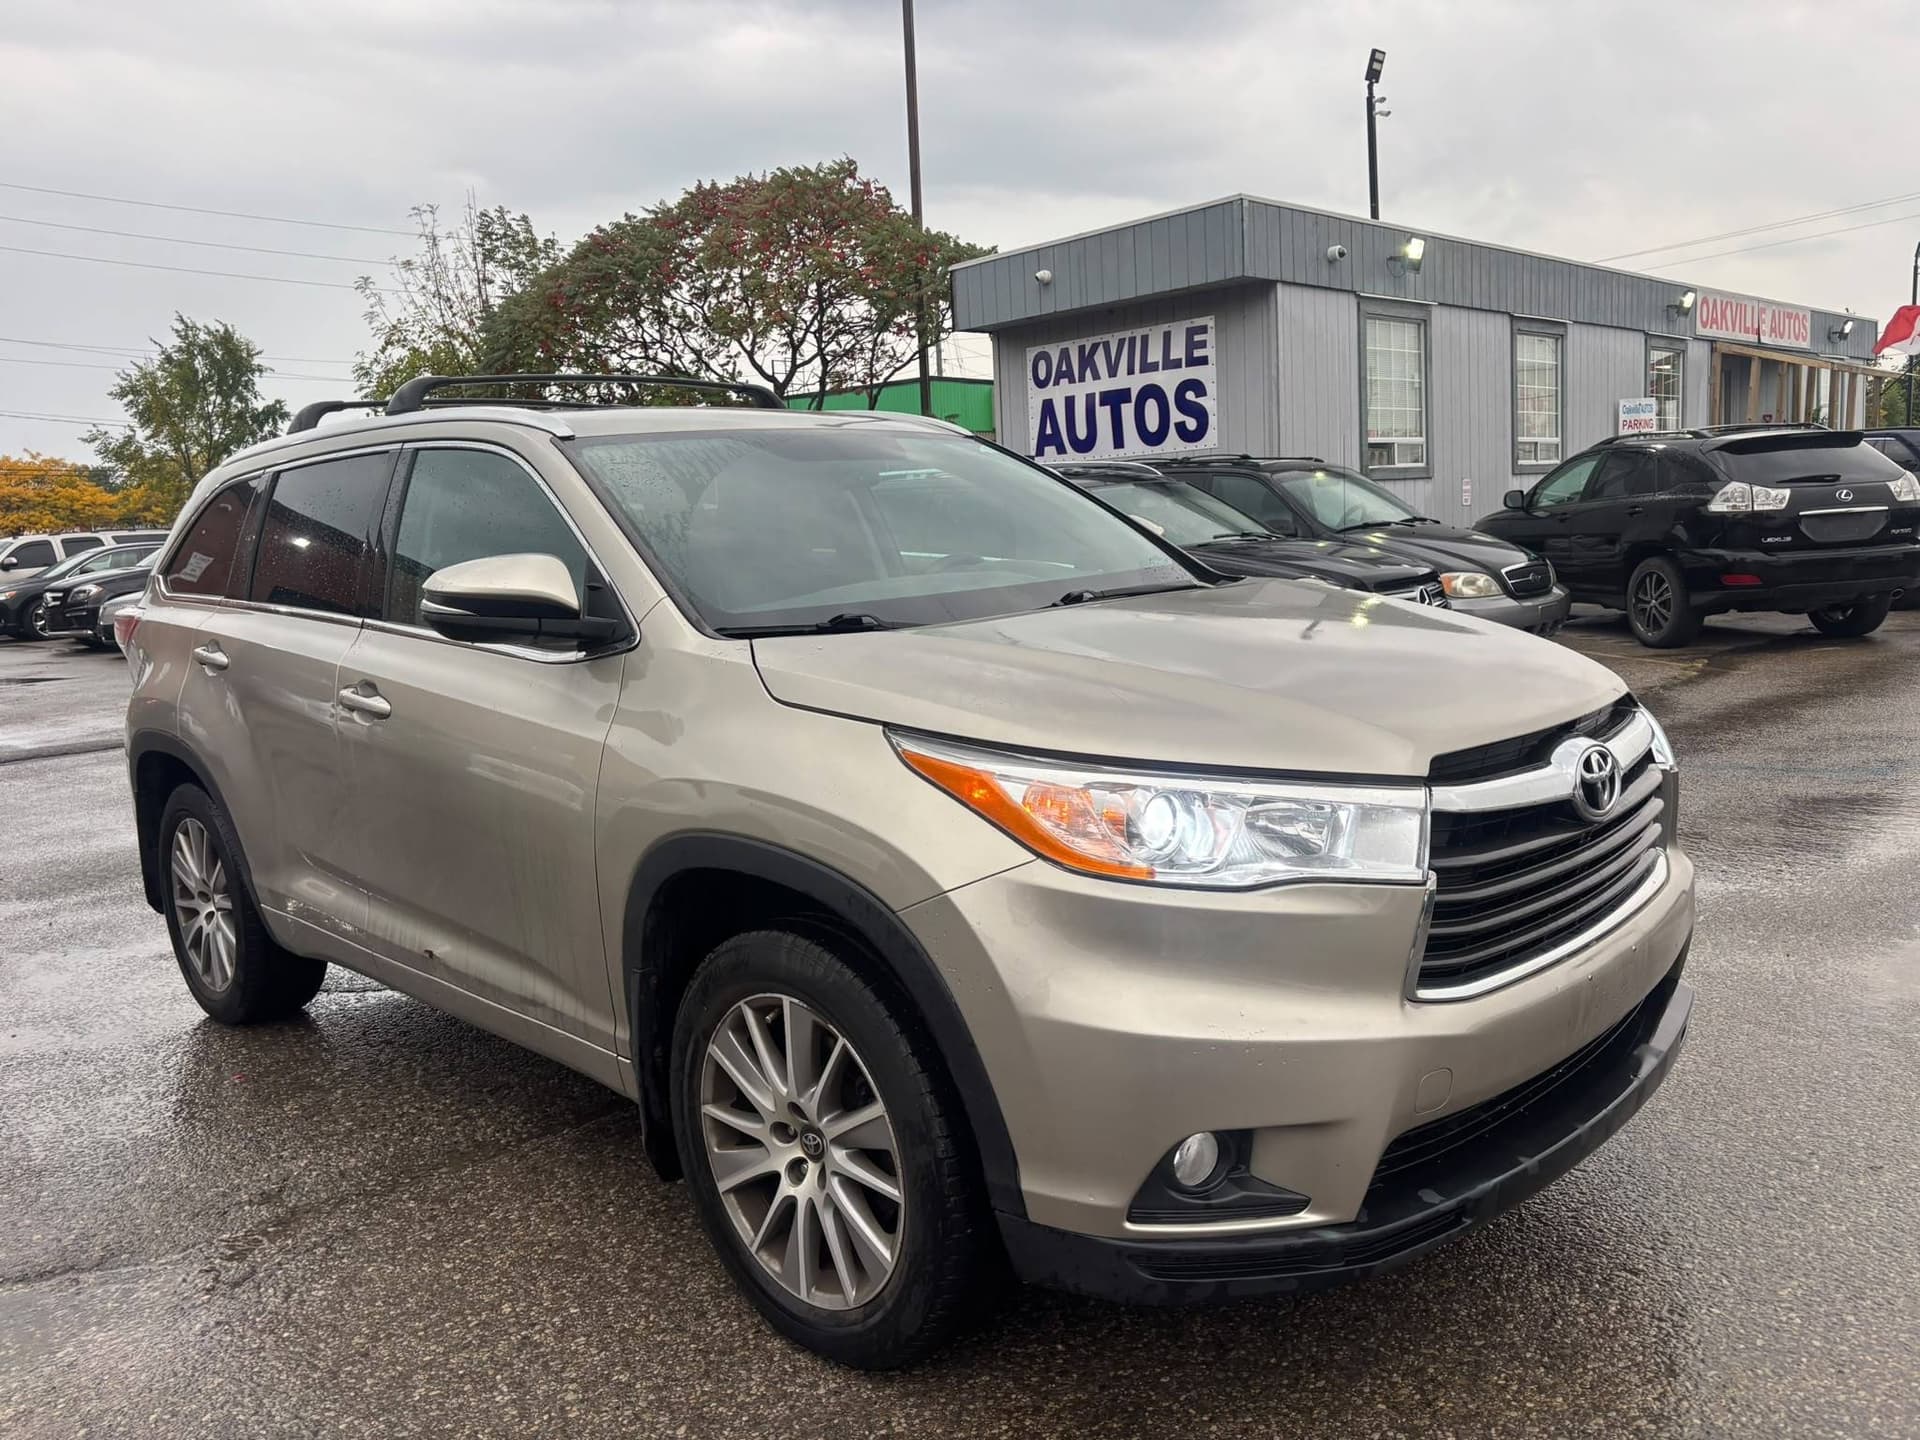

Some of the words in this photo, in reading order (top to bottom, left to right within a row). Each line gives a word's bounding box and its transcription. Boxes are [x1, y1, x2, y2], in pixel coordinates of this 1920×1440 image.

[1700, 296, 1766, 336] OAKVILLE
[1769, 307, 1808, 342] AUTOS
[1031, 324, 1209, 389] OAKVILLE
[1035, 378, 1210, 457] AUTOS
[1622, 418, 1654, 430] PARKING
